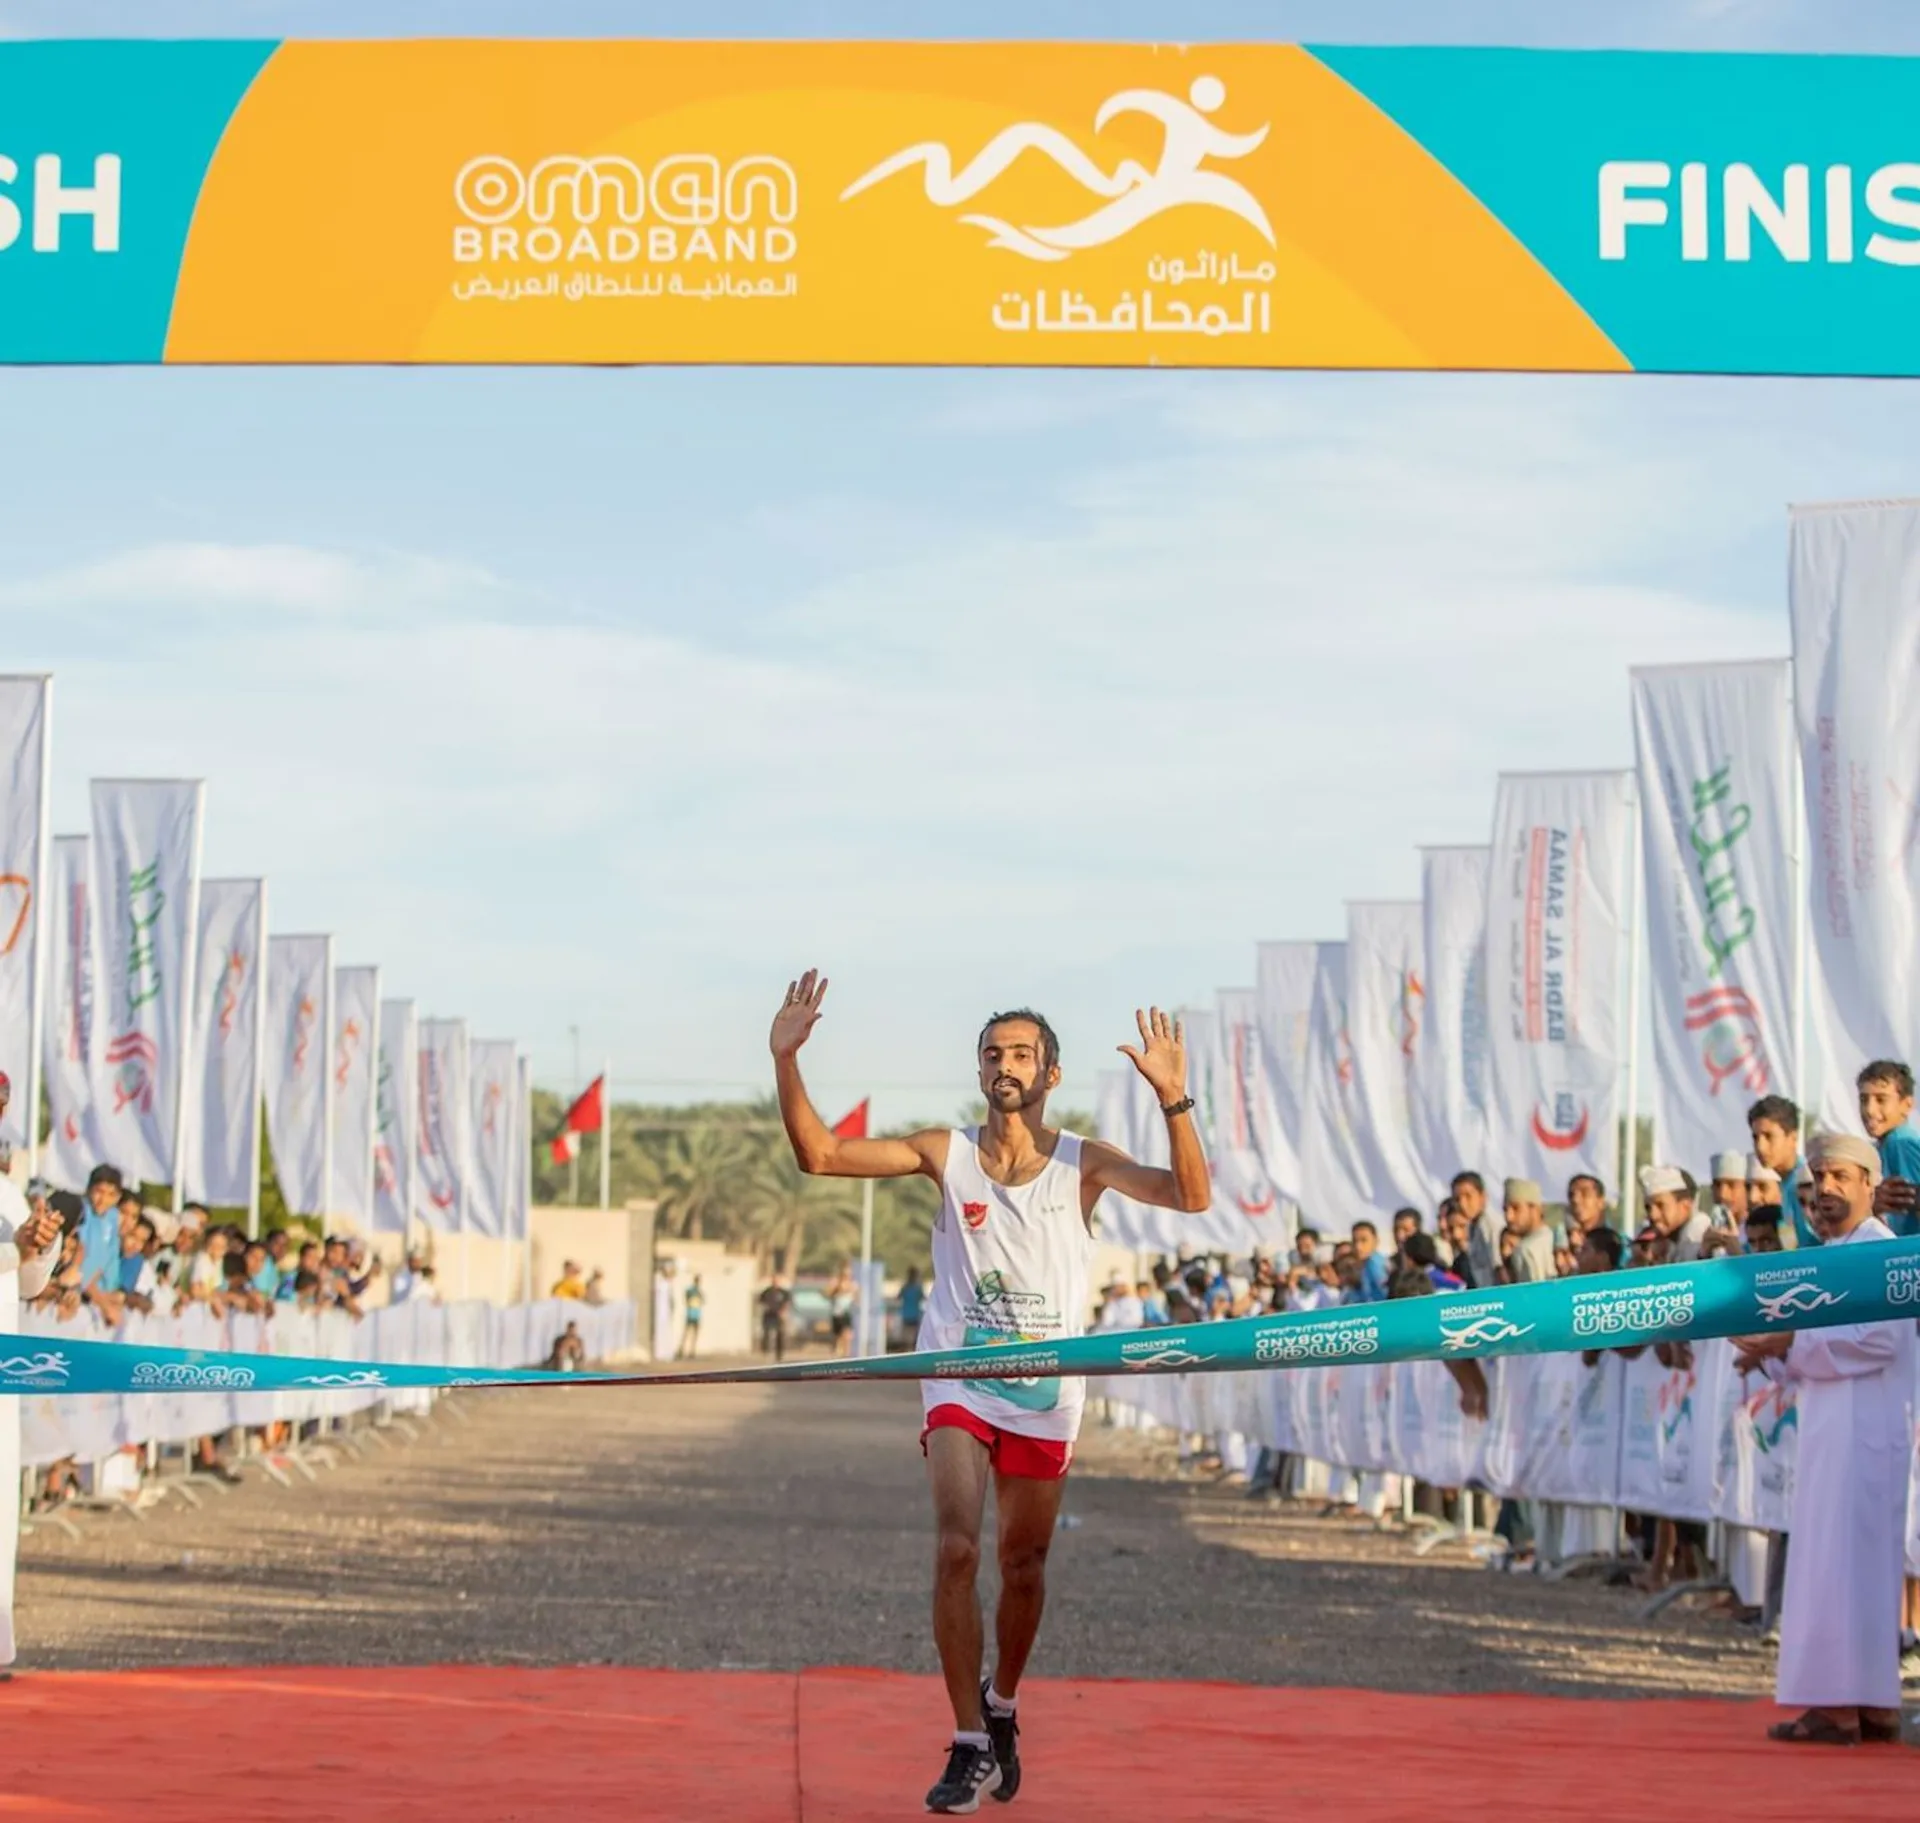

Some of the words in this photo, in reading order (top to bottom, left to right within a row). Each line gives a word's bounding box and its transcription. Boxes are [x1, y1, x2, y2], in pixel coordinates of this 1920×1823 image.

[0, 153, 121, 252] H
[454, 153, 798, 226] oman
[453, 226, 798, 263] BROADBAND
[1147, 248, 1277, 285] ماراثون
[452, 272, 558, 301] العريض
[564, 272, 663, 300] للنطاق
[668, 272, 798, 299] العمانية
[991, 289, 1271, 336] المحافظات
[1573, 1293, 1694, 1317] BROADBAND
[1256, 1327, 1378, 1349] BROADBAND
